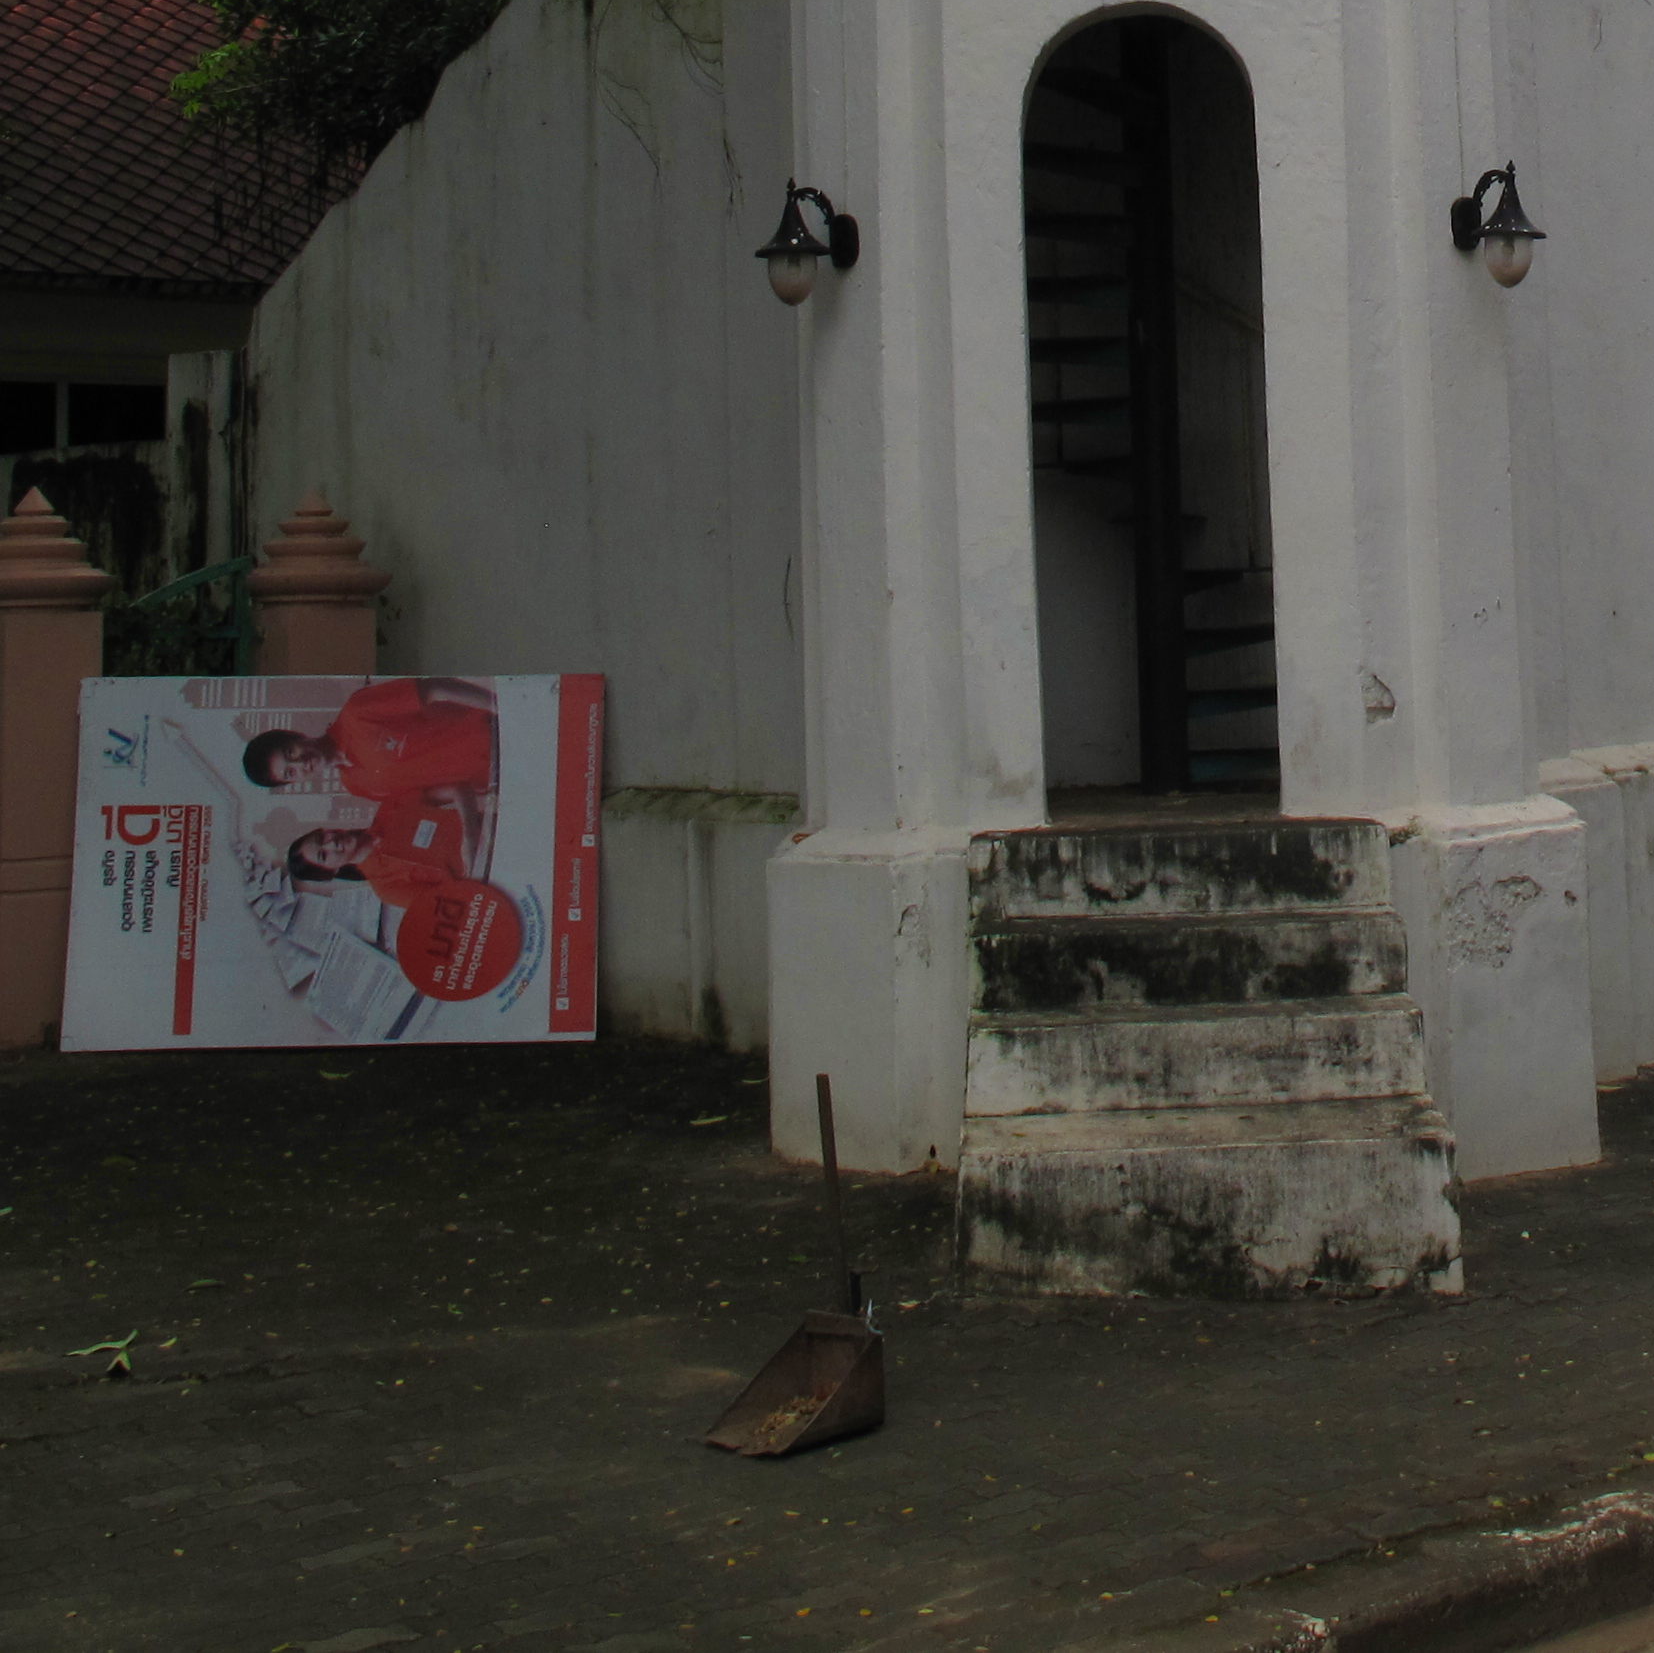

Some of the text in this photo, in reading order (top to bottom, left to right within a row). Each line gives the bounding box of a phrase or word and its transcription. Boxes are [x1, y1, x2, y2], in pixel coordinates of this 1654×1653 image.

[101, 805, 161, 845] ดี
[162, 805, 183, 887] กับเรา มาดี
[102, 850, 117, 887] ธุรกิจ
[121, 850, 136, 932] อุตสาหกรรม
[141, 850, 159, 934] เพราะมีข้อมูล
[179, 805, 199, 960] สำมะโนธุรกิจและอุตสาหกรรม
[426, 897, 465, 983] เรา มาดี
[447, 893, 484, 991] มาทำสำมะโนธุรกิจ
[463, 900, 498, 990] และอุตสาหกรรม
